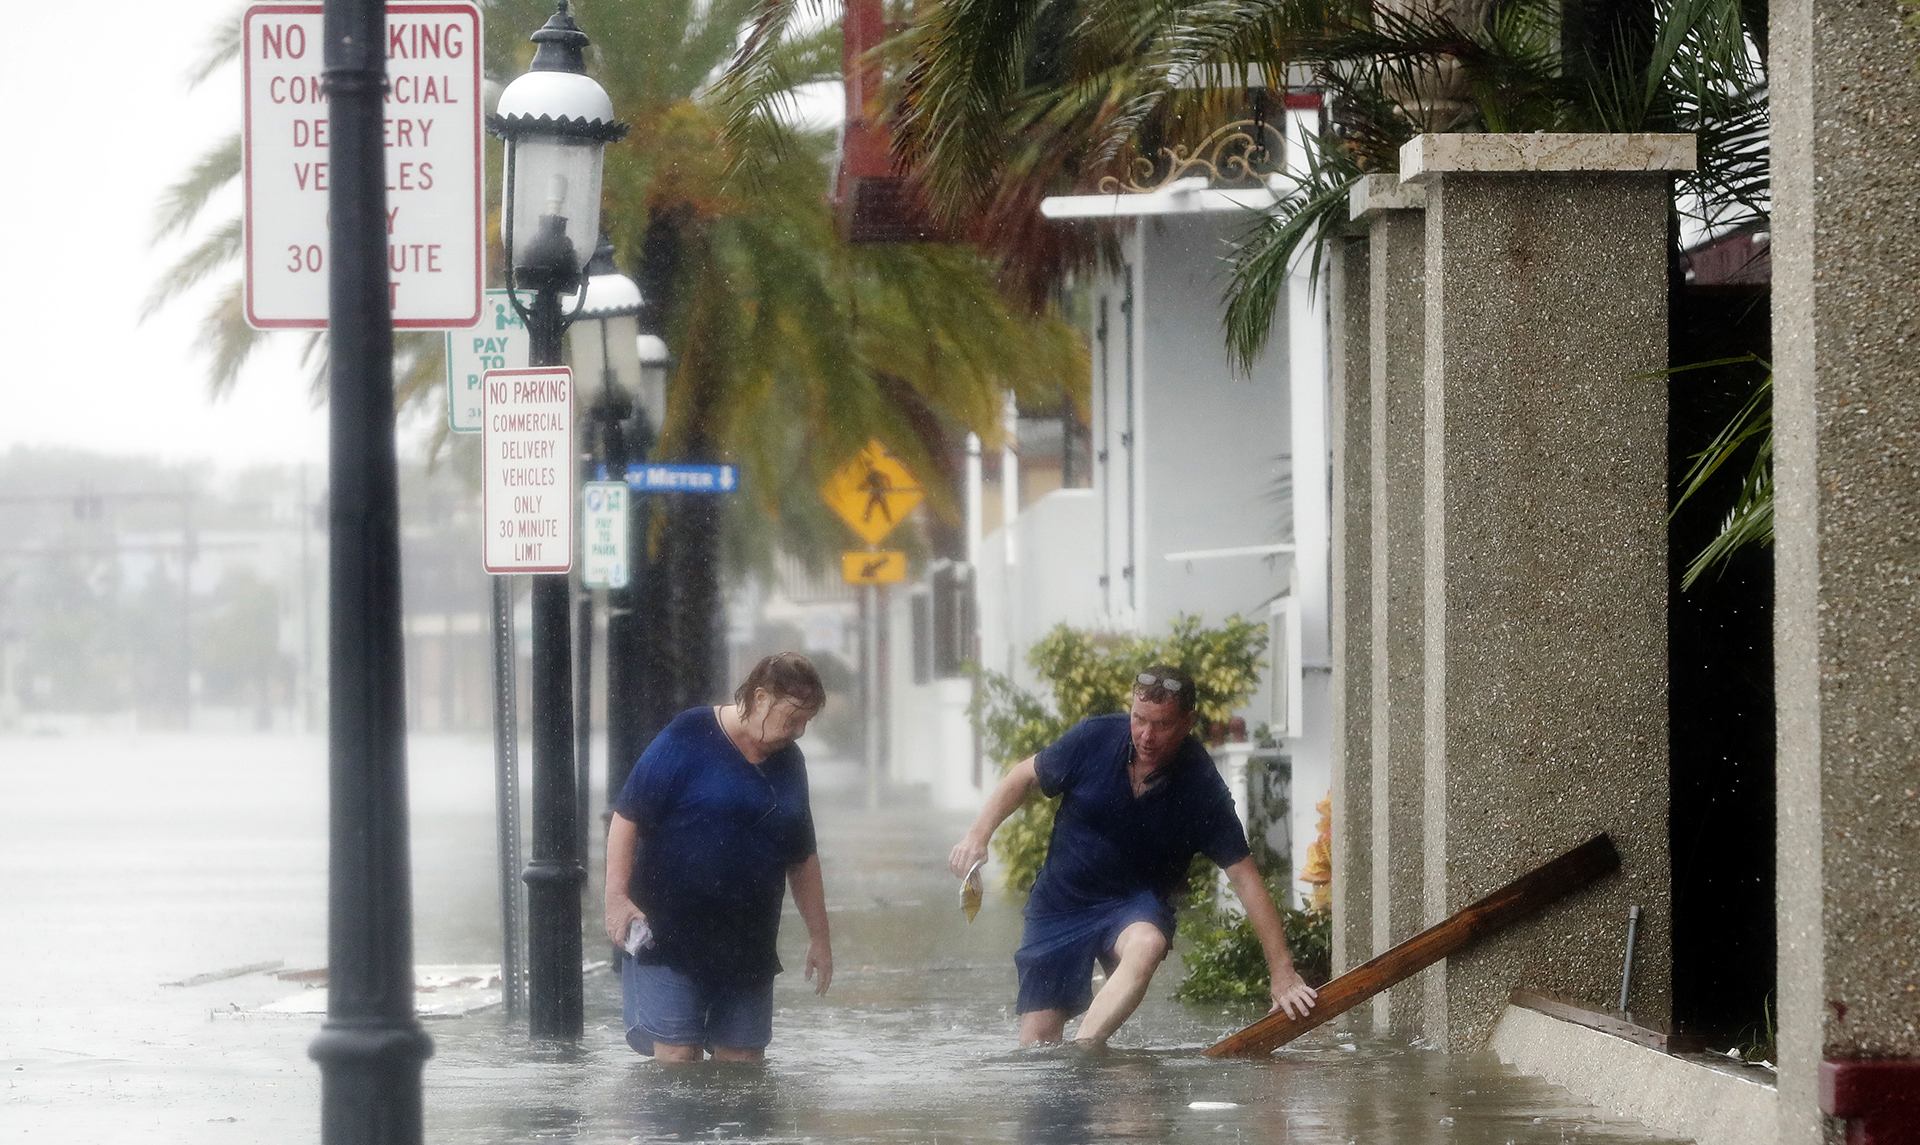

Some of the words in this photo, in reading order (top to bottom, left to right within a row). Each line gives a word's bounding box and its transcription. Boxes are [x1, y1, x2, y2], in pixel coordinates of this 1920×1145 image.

[262, 24, 306, 59] NO
[389, 23, 463, 59] KING
[270, 76, 458, 104] COMCIAL
[287, 245, 323, 273] 30
[390, 245, 442, 273] UTE
[473, 337, 508, 353] PAY
[479, 355, 505, 371] TO
[490, 382, 507, 404] NO
[514, 380, 566, 404] PARKING
[493, 413, 564, 432] COMMERCIAL
[502, 440, 555, 459] DELIVERY
[502, 468, 555, 486] VEHICLES
[514, 496, 542, 514] ONLY
[499, 520, 514, 538] 30
[519, 519, 557, 537] MINUTE
[515, 543, 542, 561] LIMIT
